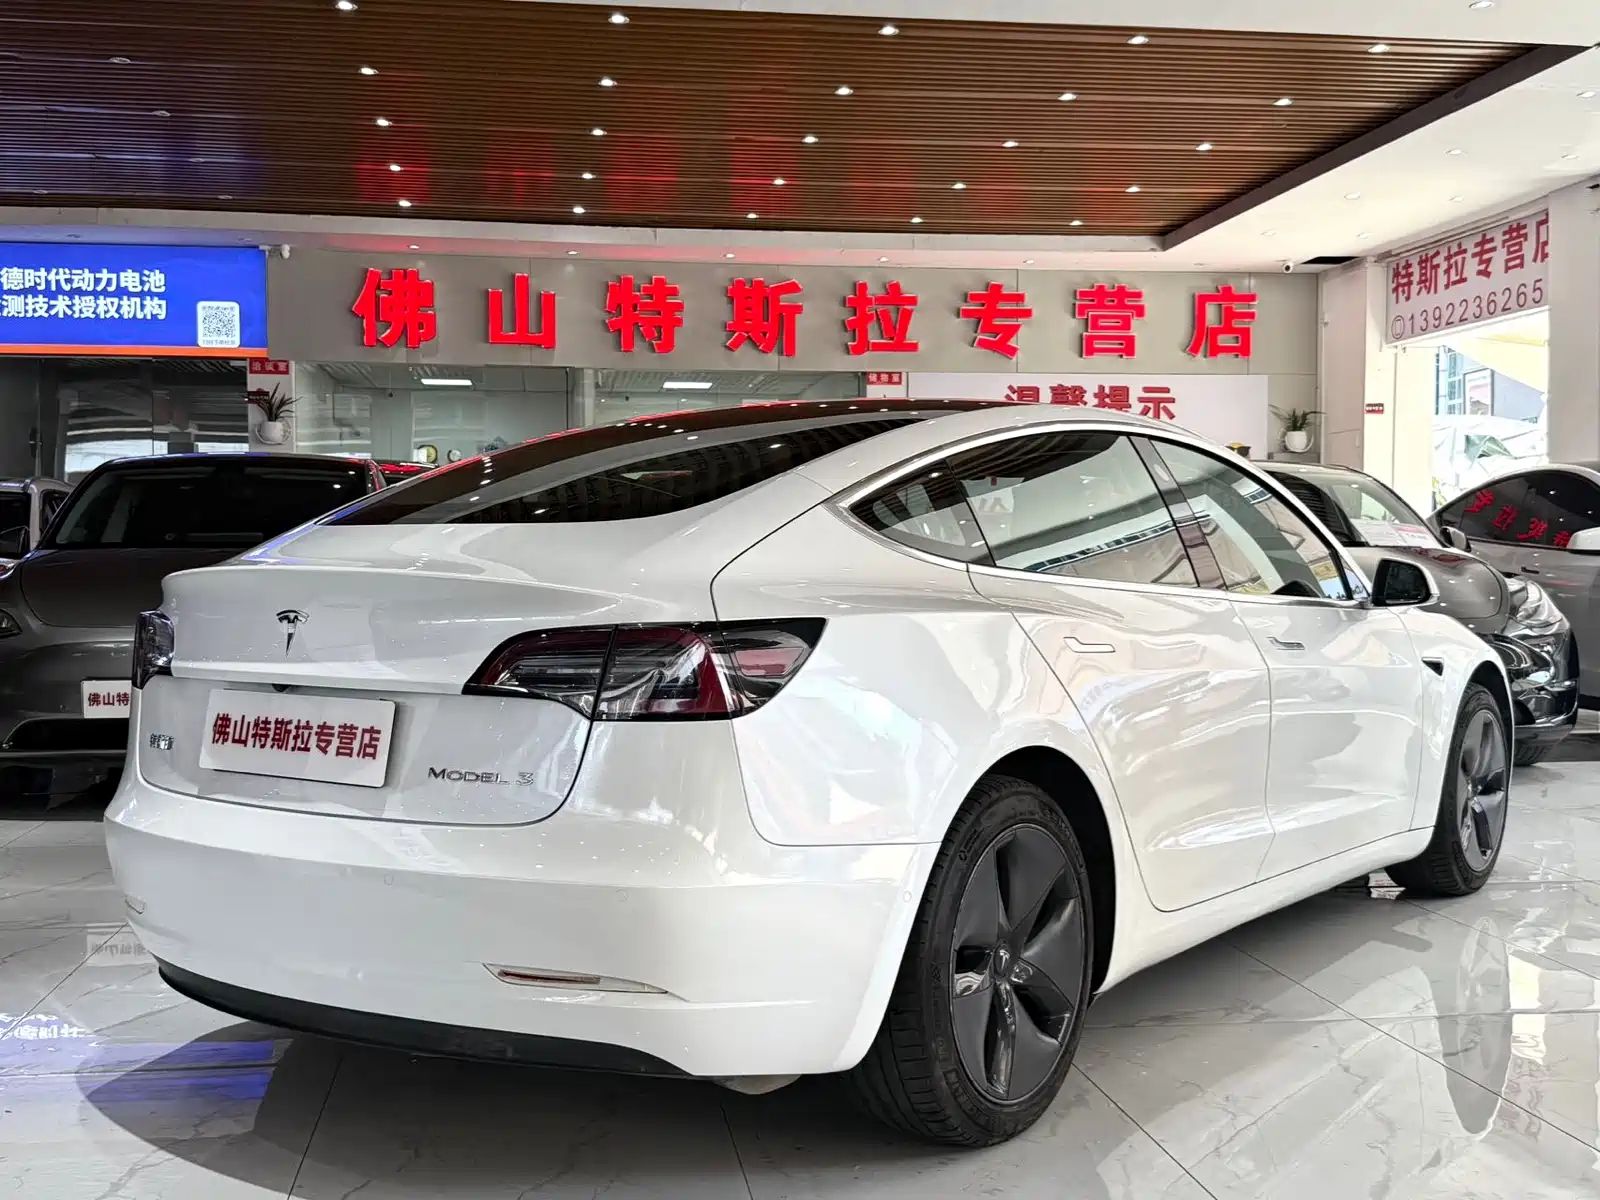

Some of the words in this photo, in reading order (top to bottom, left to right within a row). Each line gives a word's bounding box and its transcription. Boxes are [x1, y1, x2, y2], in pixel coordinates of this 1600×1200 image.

[1391, 212, 1549, 304] 特斯拉专营店
[0, 267, 165, 293] 德时代动力电池
[0, 294, 167, 320] 测技术授权机构
[352, 267, 1258, 359] 佛山特斯拉专营店
[1408, 278, 1543, 335] 1392236265
[88, 692, 130, 707] 佛山特
[212, 713, 381, 760] 佛山特斯拉专营店
[428, 767, 510, 786] MODEL
[516, 772, 534, 786] 3
